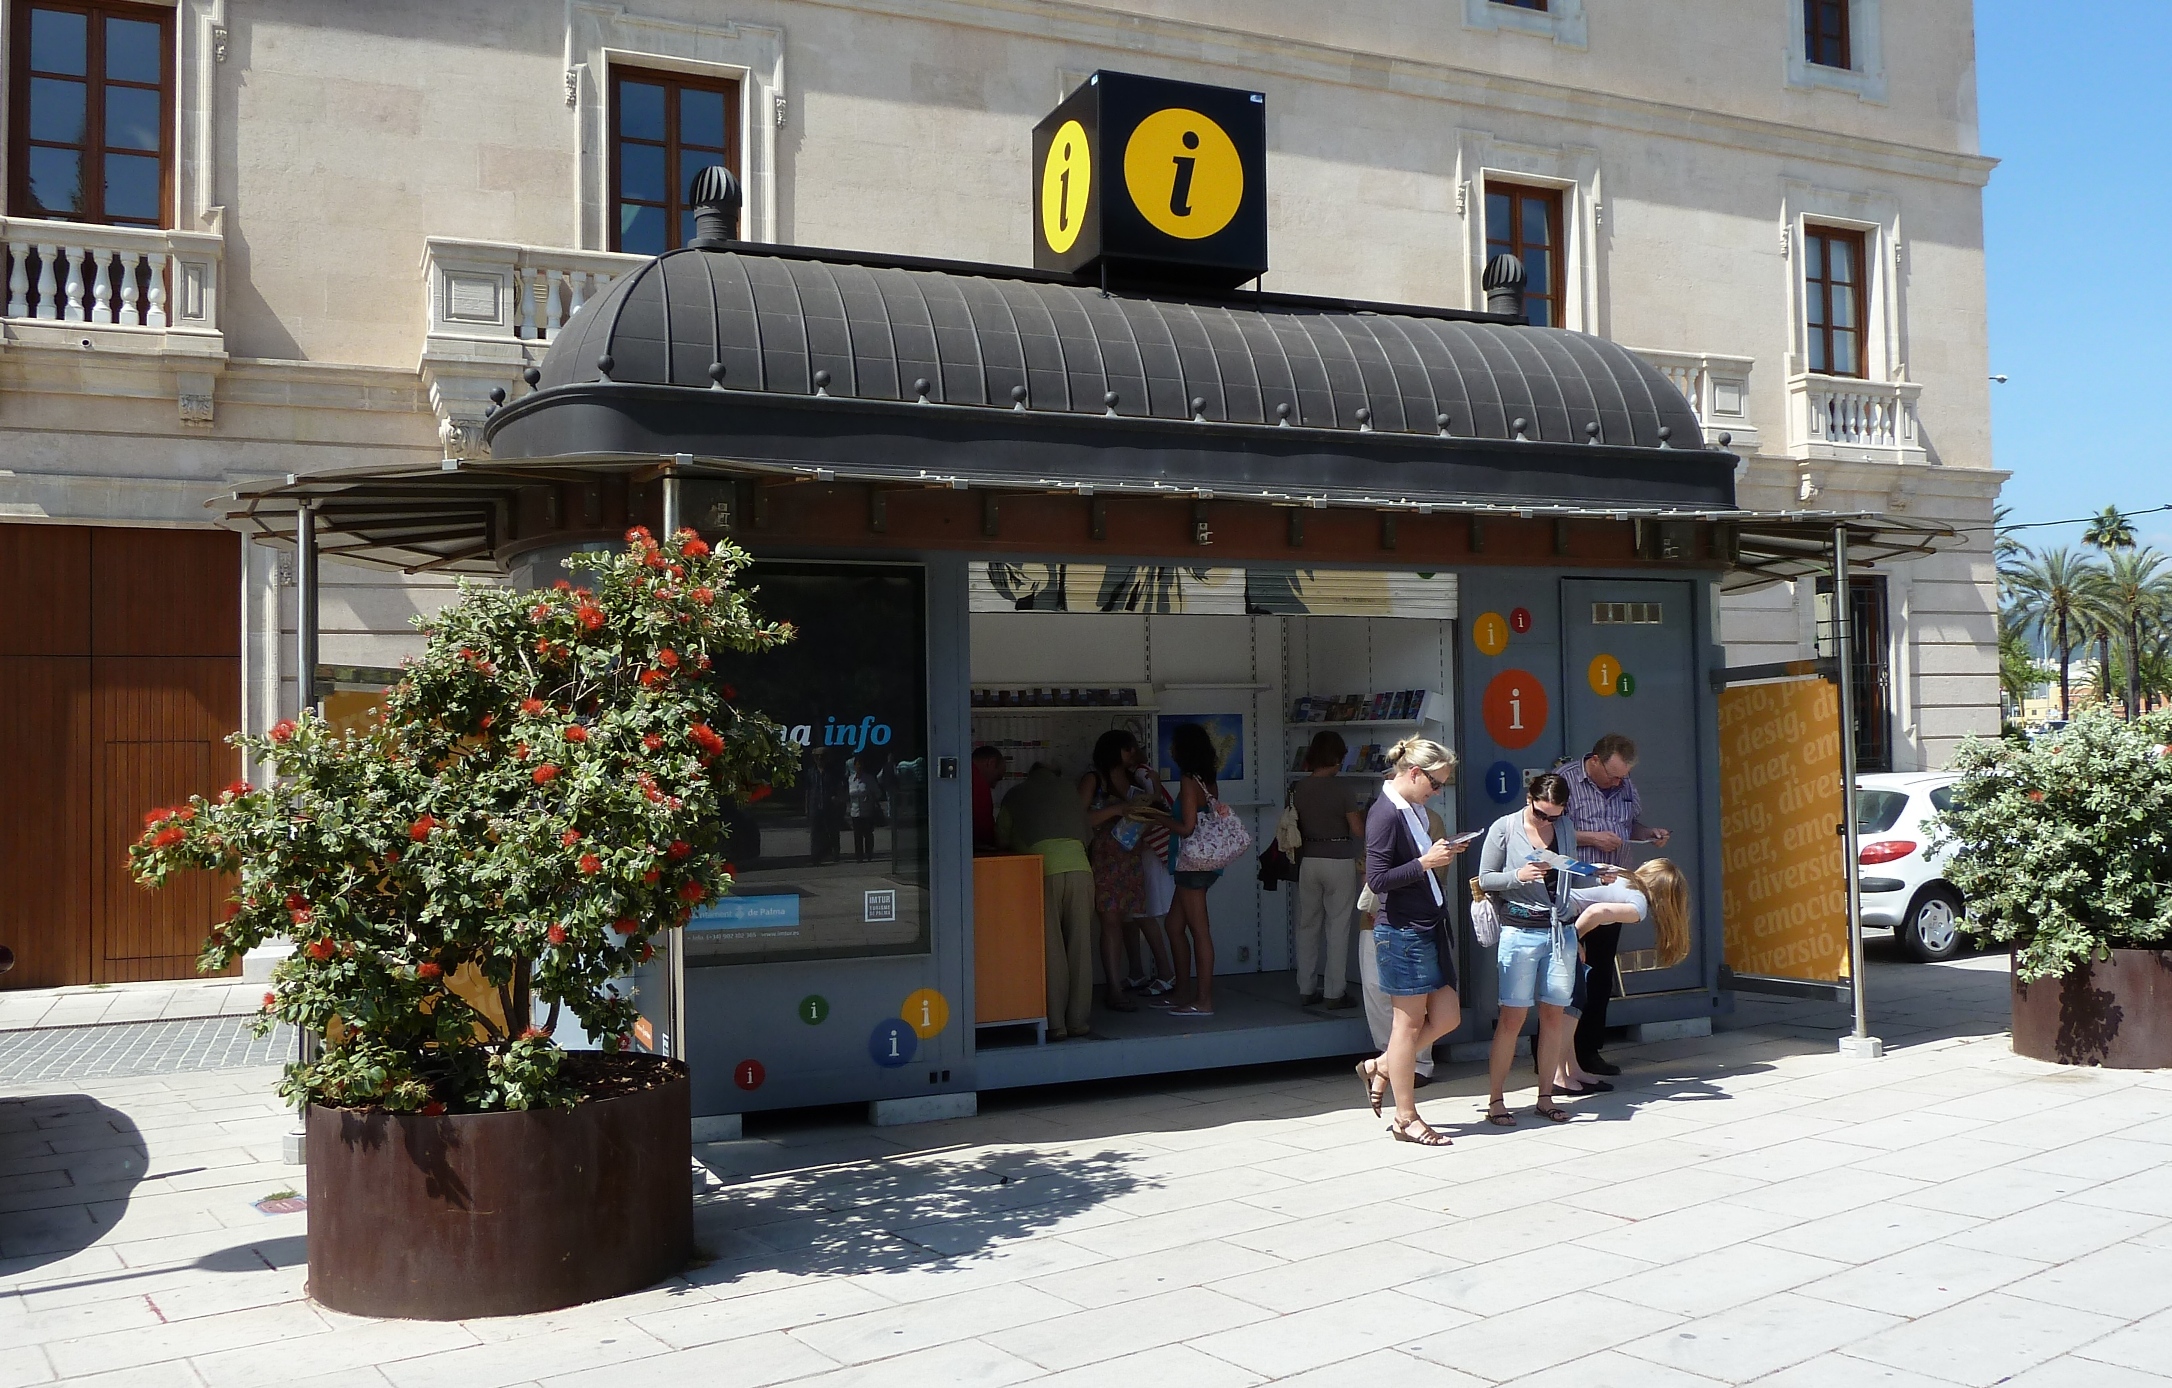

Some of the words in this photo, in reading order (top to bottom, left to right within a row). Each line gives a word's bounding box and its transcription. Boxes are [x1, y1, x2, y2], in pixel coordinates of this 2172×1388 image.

[1059, 142, 1072, 232] i
[1170, 131, 1200, 217] i
[1487, 622, 1495, 646] i
[1518, 613, 1525, 628] i
[1601, 663, 1609, 686] i
[1622, 677, 1629, 692] i
[1509, 688, 1524, 729] i
[824, 716, 891, 753] info
[1737, 709, 1807, 757] desig,
[1499, 771, 1507, 794] i
[1729, 751, 1797, 806] plaer,
[747, 908, 759, 917] de
[760, 907, 786, 917] Palma
[1753, 879, 1845, 937] emoció
[810, 1002, 818, 1019] i
[921, 999, 931, 1027] i
[889, 1030, 900, 1057] i
[746, 1067, 754, 1084] i
